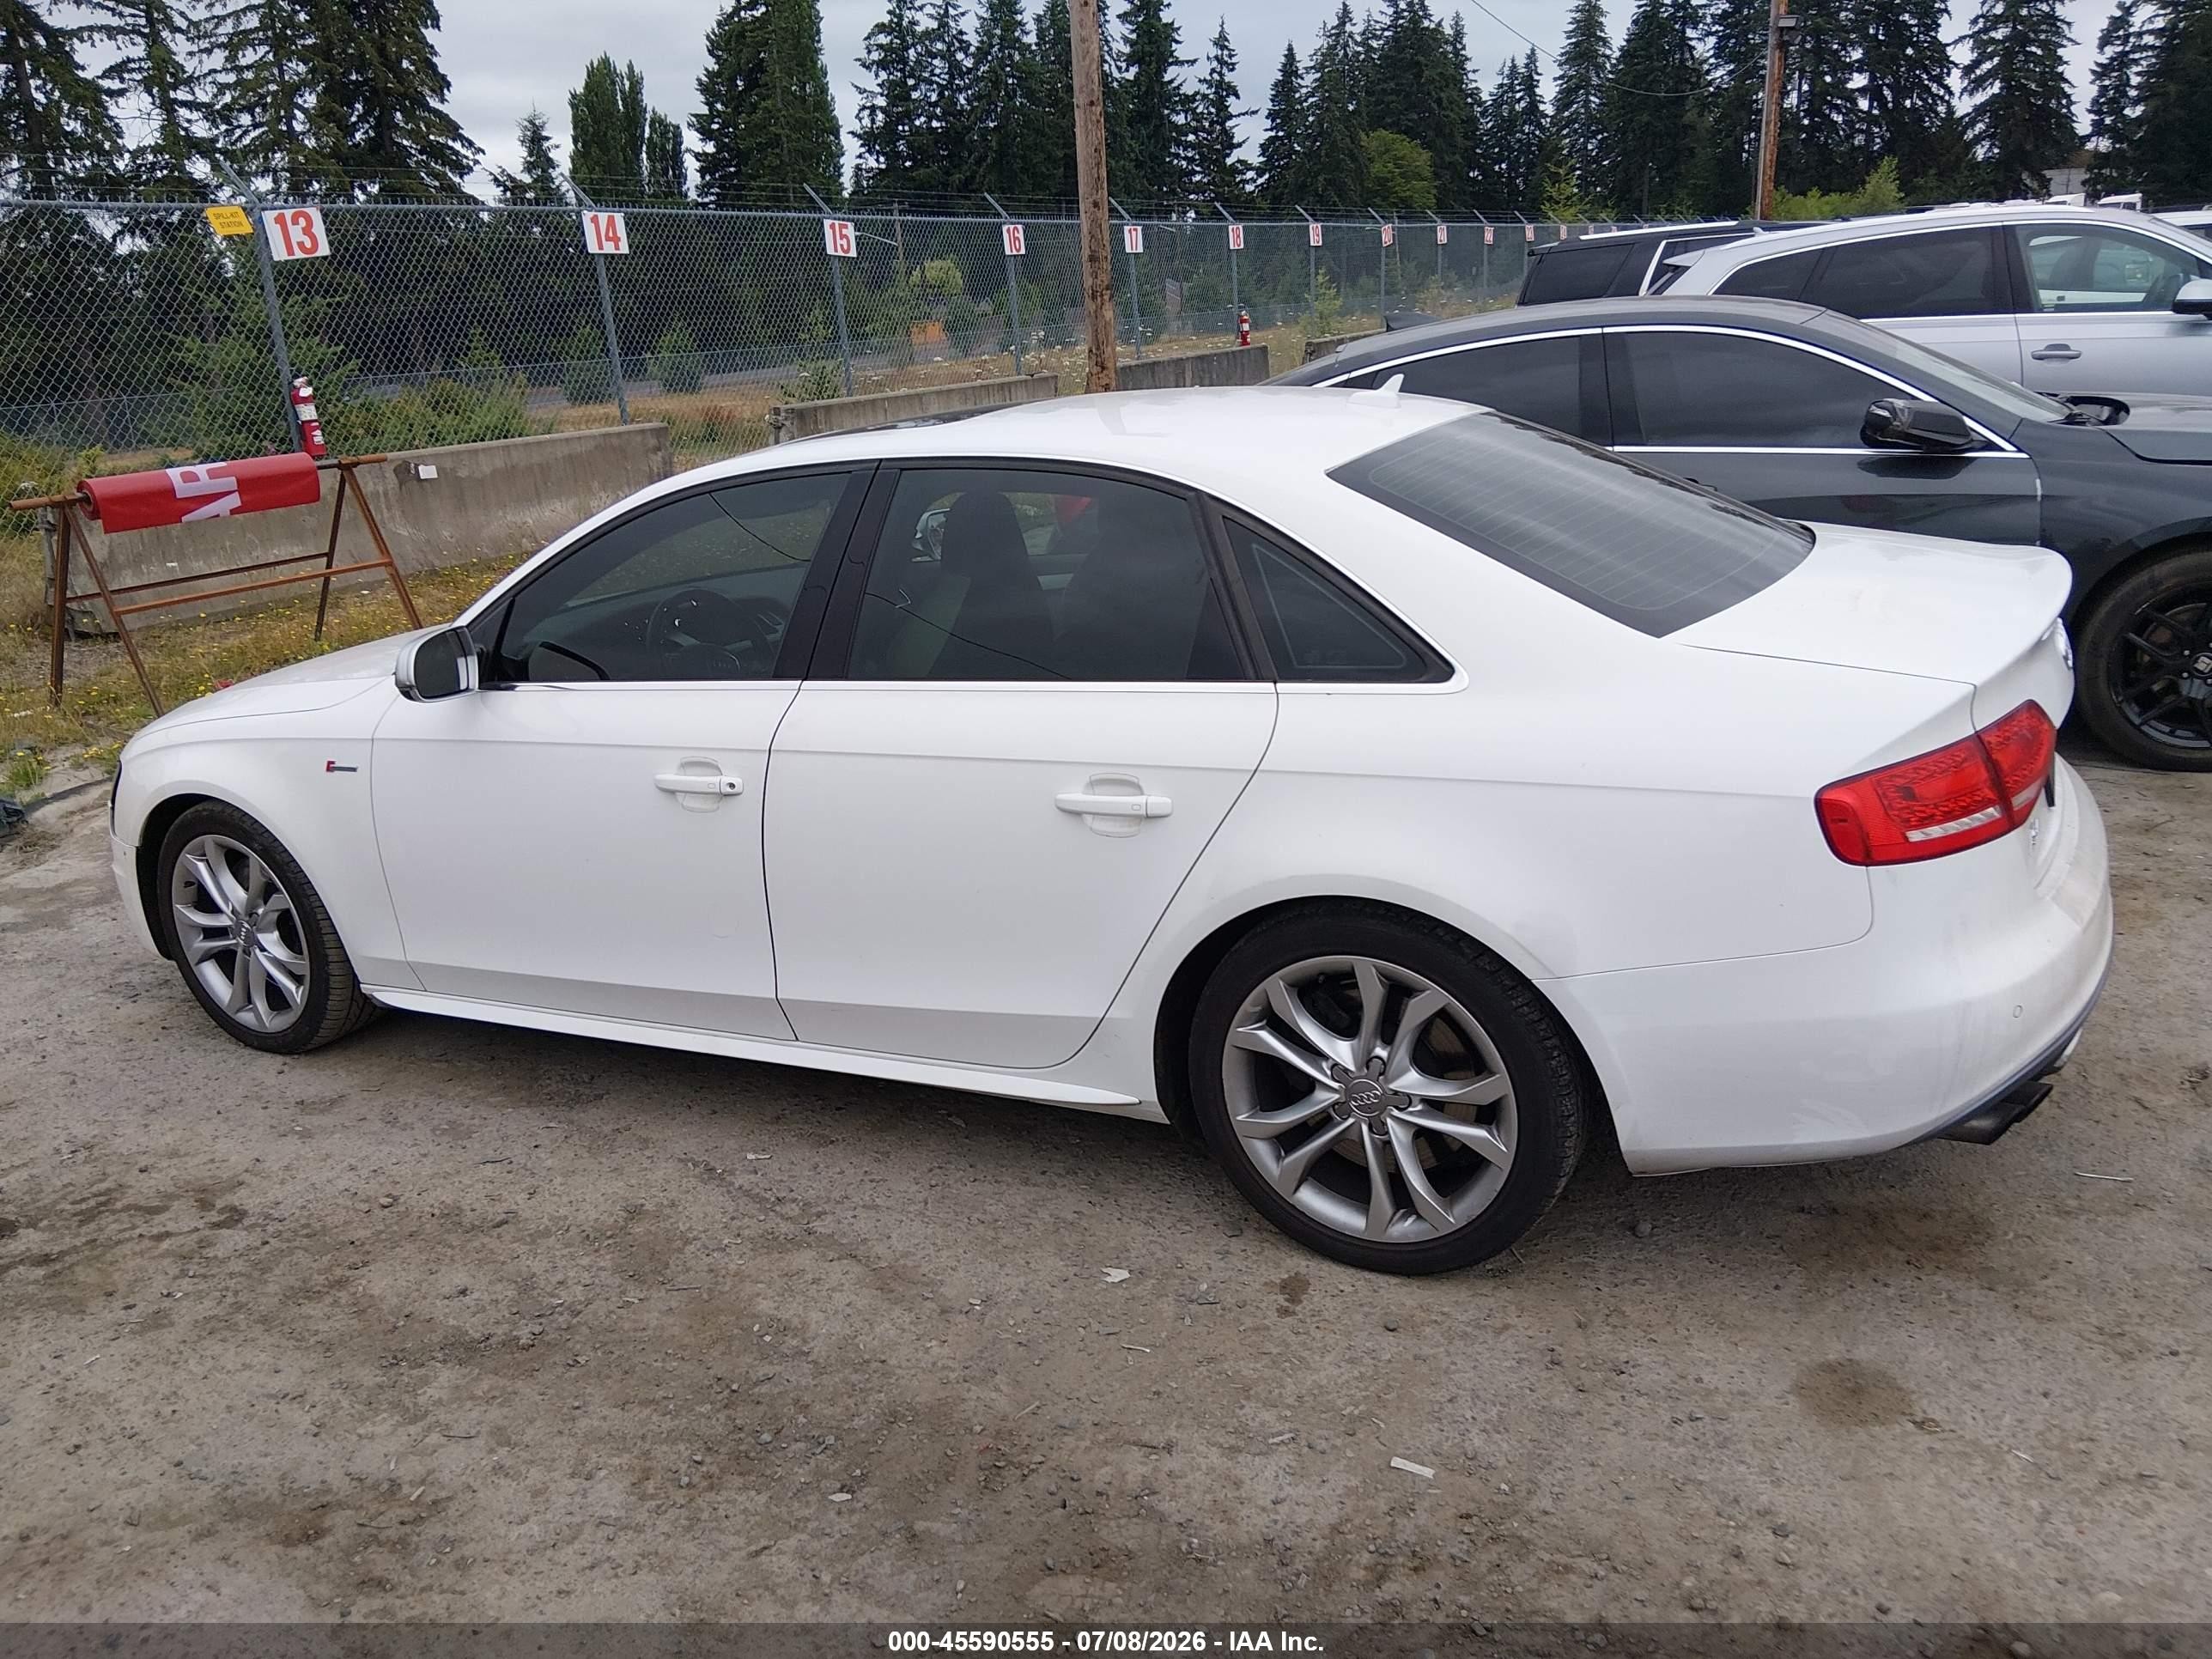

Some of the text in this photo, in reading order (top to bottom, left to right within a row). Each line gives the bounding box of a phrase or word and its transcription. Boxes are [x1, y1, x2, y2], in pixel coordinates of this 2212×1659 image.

[274, 210, 319, 257] 13
[590, 214, 622, 251] 14
[829, 222, 851, 255] 15
[1006, 225, 1022, 253] 16
[1127, 227, 1139, 252] 17
[1231, 226, 1242, 248] 18
[1311, 225, 1320, 245] 19
[1382, 225, 1392, 245] 20
[1438, 226, 1445, 243] 21
